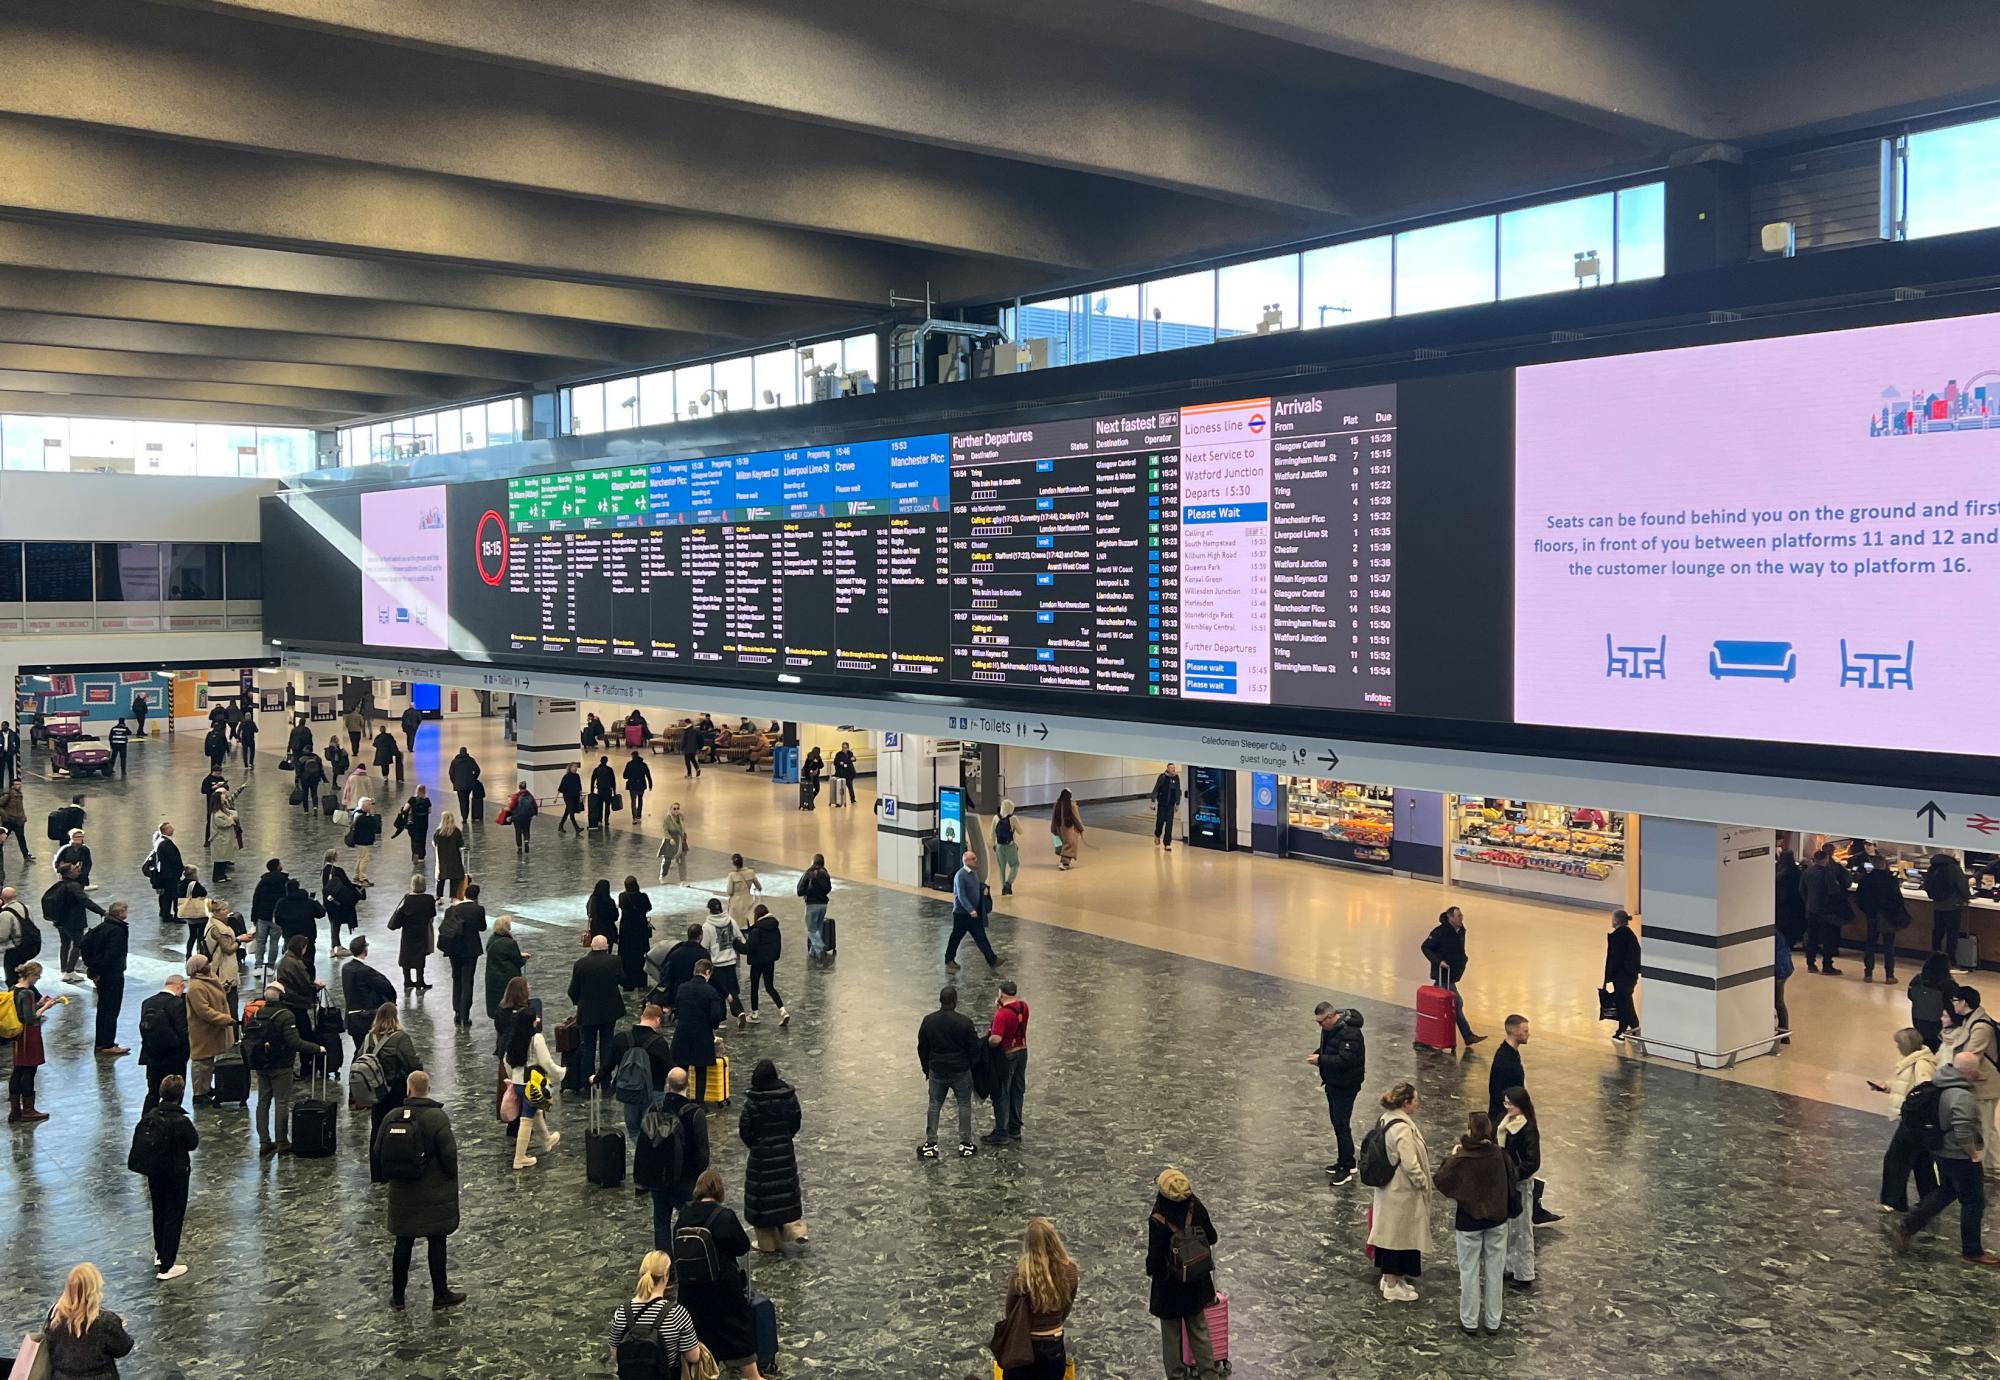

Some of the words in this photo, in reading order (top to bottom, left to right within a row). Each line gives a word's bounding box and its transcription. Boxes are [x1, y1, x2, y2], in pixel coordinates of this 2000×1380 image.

[1275, 397, 1322, 416] Arrivals
[1096, 420, 1120, 434] Next
[1121, 416, 1156, 432] fastest
[1185, 424, 1222, 435] Lioness
[1224, 420, 1243, 432] line
[1274, 423, 1294, 431] From
[1343, 416, 1358, 425] Plat
[1376, 412, 1392, 422] Due
[892, 441, 907, 451] 15:53
[953, 435, 983, 449] Further
[985, 431, 1033, 447] Departures
[1096, 438, 1128, 448] Destination
[1144, 435, 1172, 445] Operator
[1274, 443, 1301, 452] Glasgow
[1302, 439, 1326, 448] Central
[1350, 436, 1358, 445] 15
[1370, 434, 1392, 443] 15:28
[971, 450, 999, 460] Destination
[1070, 442, 1088, 451] Status
[1185, 453, 1207, 463] Next
[1209, 450, 1242, 461] Service
[1244, 449, 1254, 458] to
[1274, 456, 1312, 466] Birmingham
[1313, 454, 1328, 463] New
[1329, 454, 1336, 462] St
[1353, 452, 1358, 460] 7
[1370, 449, 1392, 459] 15:15
[891, 456, 929, 467] Manchester
[931, 453, 944, 463] Picc
[784, 466, 808, 476] Liverpool
[809, 465, 822, 474] Lime
[823, 464, 830, 473] St
[835, 462, 855, 472] Crewe
[1185, 469, 1222, 480] Watford
[1224, 467, 1264, 478] Junction
[1274, 472, 1300, 480] Watford
[1301, 470, 1327, 479] Junction
[1353, 467, 1358, 475] 9
[1370, 465, 1391, 474] 15:21
[1185, 489, 1220, 500] Departs
[1226, 485, 1251, 496] 15:30
[1274, 487, 1291, 496] Tring
[1370, 481, 1391, 490] 15:22
[1353, 498, 1358, 506] 4
[1187, 509, 1216, 519] Please
[1219, 508, 1240, 518] Wait
[1274, 516, 1310, 524] Manchester
[1312, 515, 1326, 523] Picc
[1353, 513, 1358, 522] 3
[1370, 512, 1391, 521] 15:32
[1547, 516, 1584, 528] Seats
[1589, 516, 1613, 527] can
[1618, 513, 1636, 526] be
[1641, 512, 1686, 525] found
[1691, 509, 1746, 524] behind
[1752, 511, 1782, 526] you
[1788, 510, 1809, 521] on
[1816, 506, 1844, 520] the
[1850, 502, 1916, 523] ground
[1922, 501, 1958, 517] and
[1274, 531, 1302, 540] Liverpool
[1304, 530, 1320, 539] Lime
[1321, 530, 1328, 538] St
[1370, 528, 1391, 536] 15:35
[1535, 539, 1578, 553] floors,
[1583, 538, 1595, 551] in
[1600, 537, 1636, 550] front
[1642, 536, 1657, 550] of
[1662, 538, 1689, 553] you
[1696, 535, 1766, 549] between
[1772, 533, 1856, 550] platforms
[1863, 532, 1883, 546] 11
[1890, 530, 1924, 545] and
[1932, 530, 1954, 544] 12
[1961, 528, 1998, 544] and
[482, 541, 502, 556] 15:15
[1274, 546, 1298, 554] Chester
[1353, 544, 1358, 552] 2
[1274, 560, 1299, 568] Watford
[1353, 559, 1358, 567] 9
[1569, 562, 1592, 575] the
[1597, 563, 1667, 575] customer
[1672, 560, 1724, 577] lounge
[1730, 562, 1750, 574] on
[1756, 559, 1784, 573] the
[1790, 562, 1824, 576] way
[1830, 560, 1848, 573] to
[1854, 558, 1935, 576] platform
[1942, 557, 1971, 572] 16.
[1274, 575, 1294, 583] Milton
[1294, 575, 1317, 584] Keynes
[1370, 574, 1391, 583] 15:37
[1274, 590, 1301, 599] Glasgow
[1302, 590, 1326, 598] Central
[1349, 590, 1358, 598] 13
[1370, 590, 1391, 598] 15:40
[1274, 604, 1310, 613] Manchester
[1311, 604, 1326, 613] Picc
[1349, 605, 1358, 613] 14
[1370, 605, 1391, 614] 15:43
[1274, 619, 1311, 628] Birmingham
[1352, 620, 1358, 628] 6
[1370, 620, 1391, 629] 15:50
[1274, 633, 1300, 642] Watford
[1300, 634, 1327, 642] Junction
[1352, 636, 1358, 644] 9
[1370, 636, 1390, 644] 15:51
[1185, 642, 1212, 651] Further
[1214, 643, 1257, 653] Departures
[1274, 648, 1290, 658] Tring
[1370, 651, 1391, 660] 15:52
[1186, 663, 1208, 671] Please
[1274, 662, 1311, 672] Birmingham
[1312, 664, 1327, 672] New
[1328, 664, 1336, 673] St
[1370, 667, 1391, 676] 15:54
[602, 684, 628, 696] Platforms
[638, 688, 643, 697] 11
[1186, 680, 1208, 688] Please
[1364, 693, 1391, 702] infotec
[980, 718, 1010, 734] Toilets
[1201, 735, 1240, 747] Caledonian
[1241, 739, 1268, 751] Sleeper
[1270, 742, 1287, 752] Club
[1240, 755, 1260, 765] guest
[1262, 756, 1286, 768] lounge
